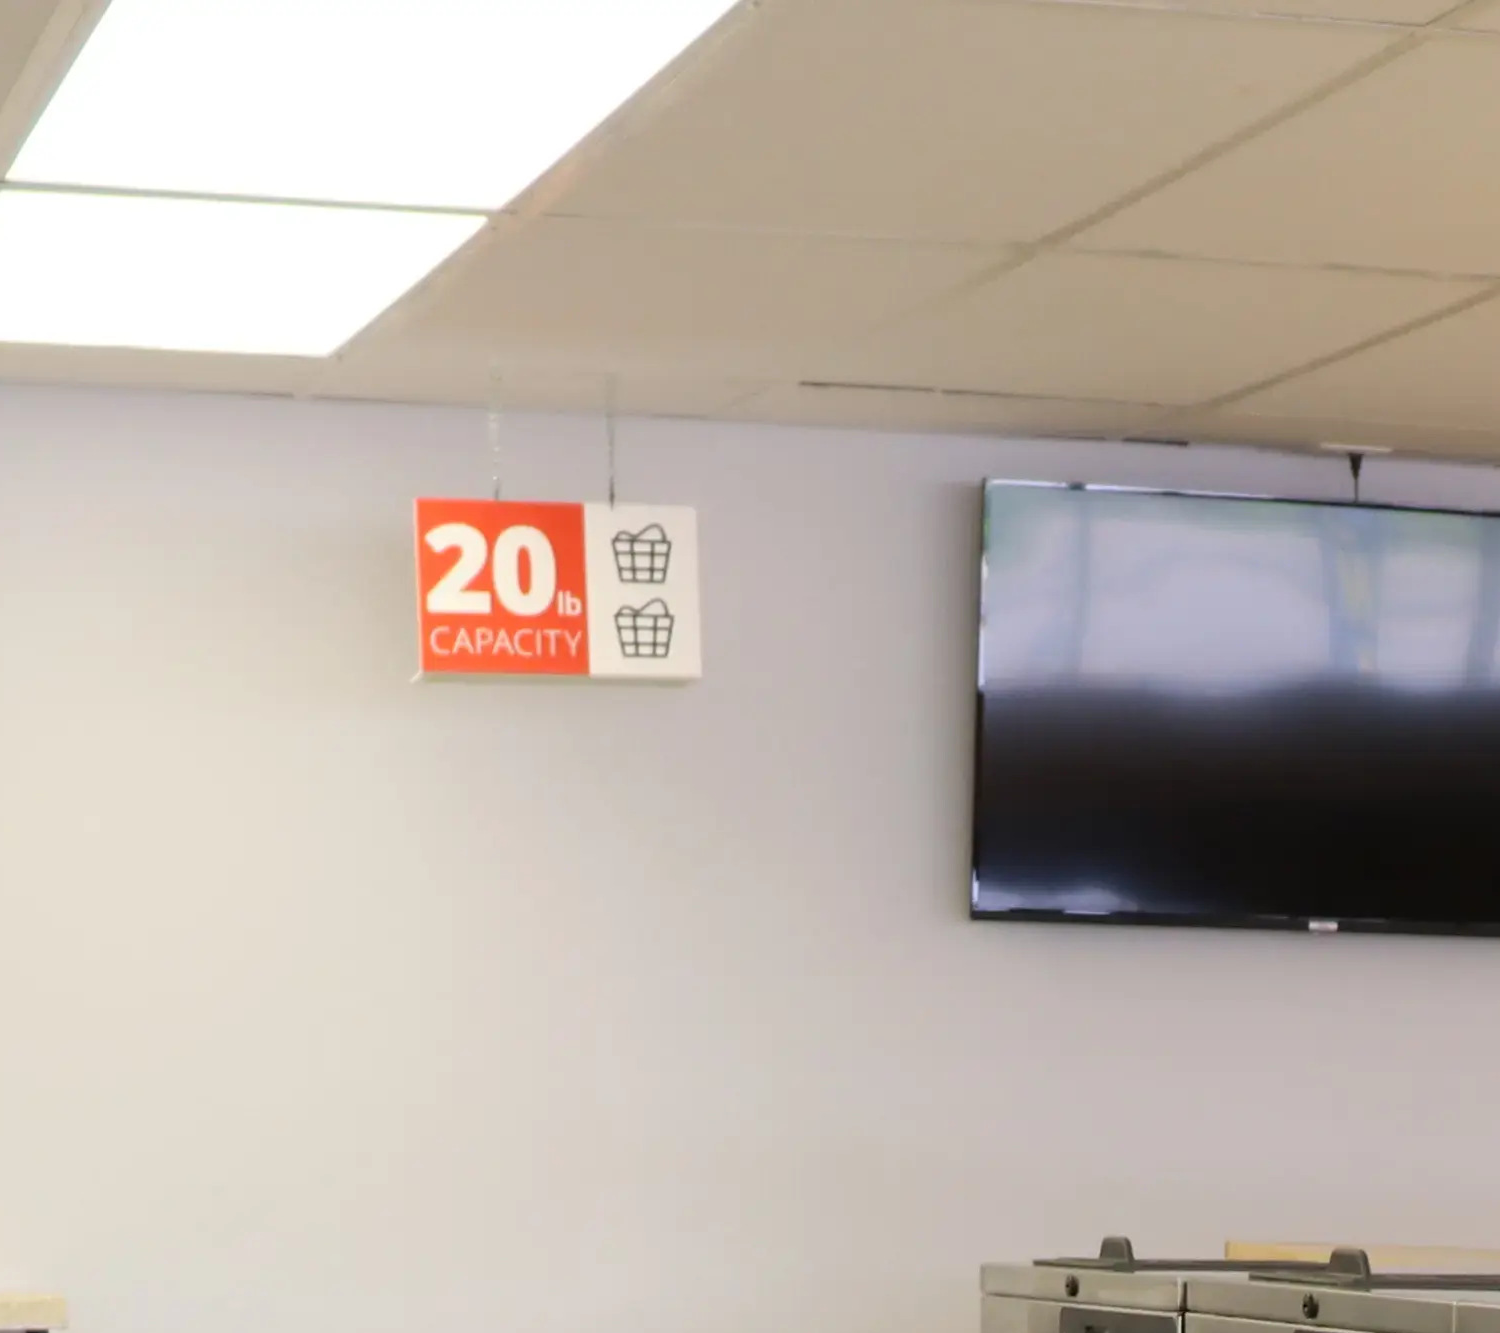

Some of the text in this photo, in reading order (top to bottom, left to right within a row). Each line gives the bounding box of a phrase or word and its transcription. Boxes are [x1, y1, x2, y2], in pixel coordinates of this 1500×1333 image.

[424, 522, 582, 616] 20 lb
[429, 626, 582, 659] CAPACITY
